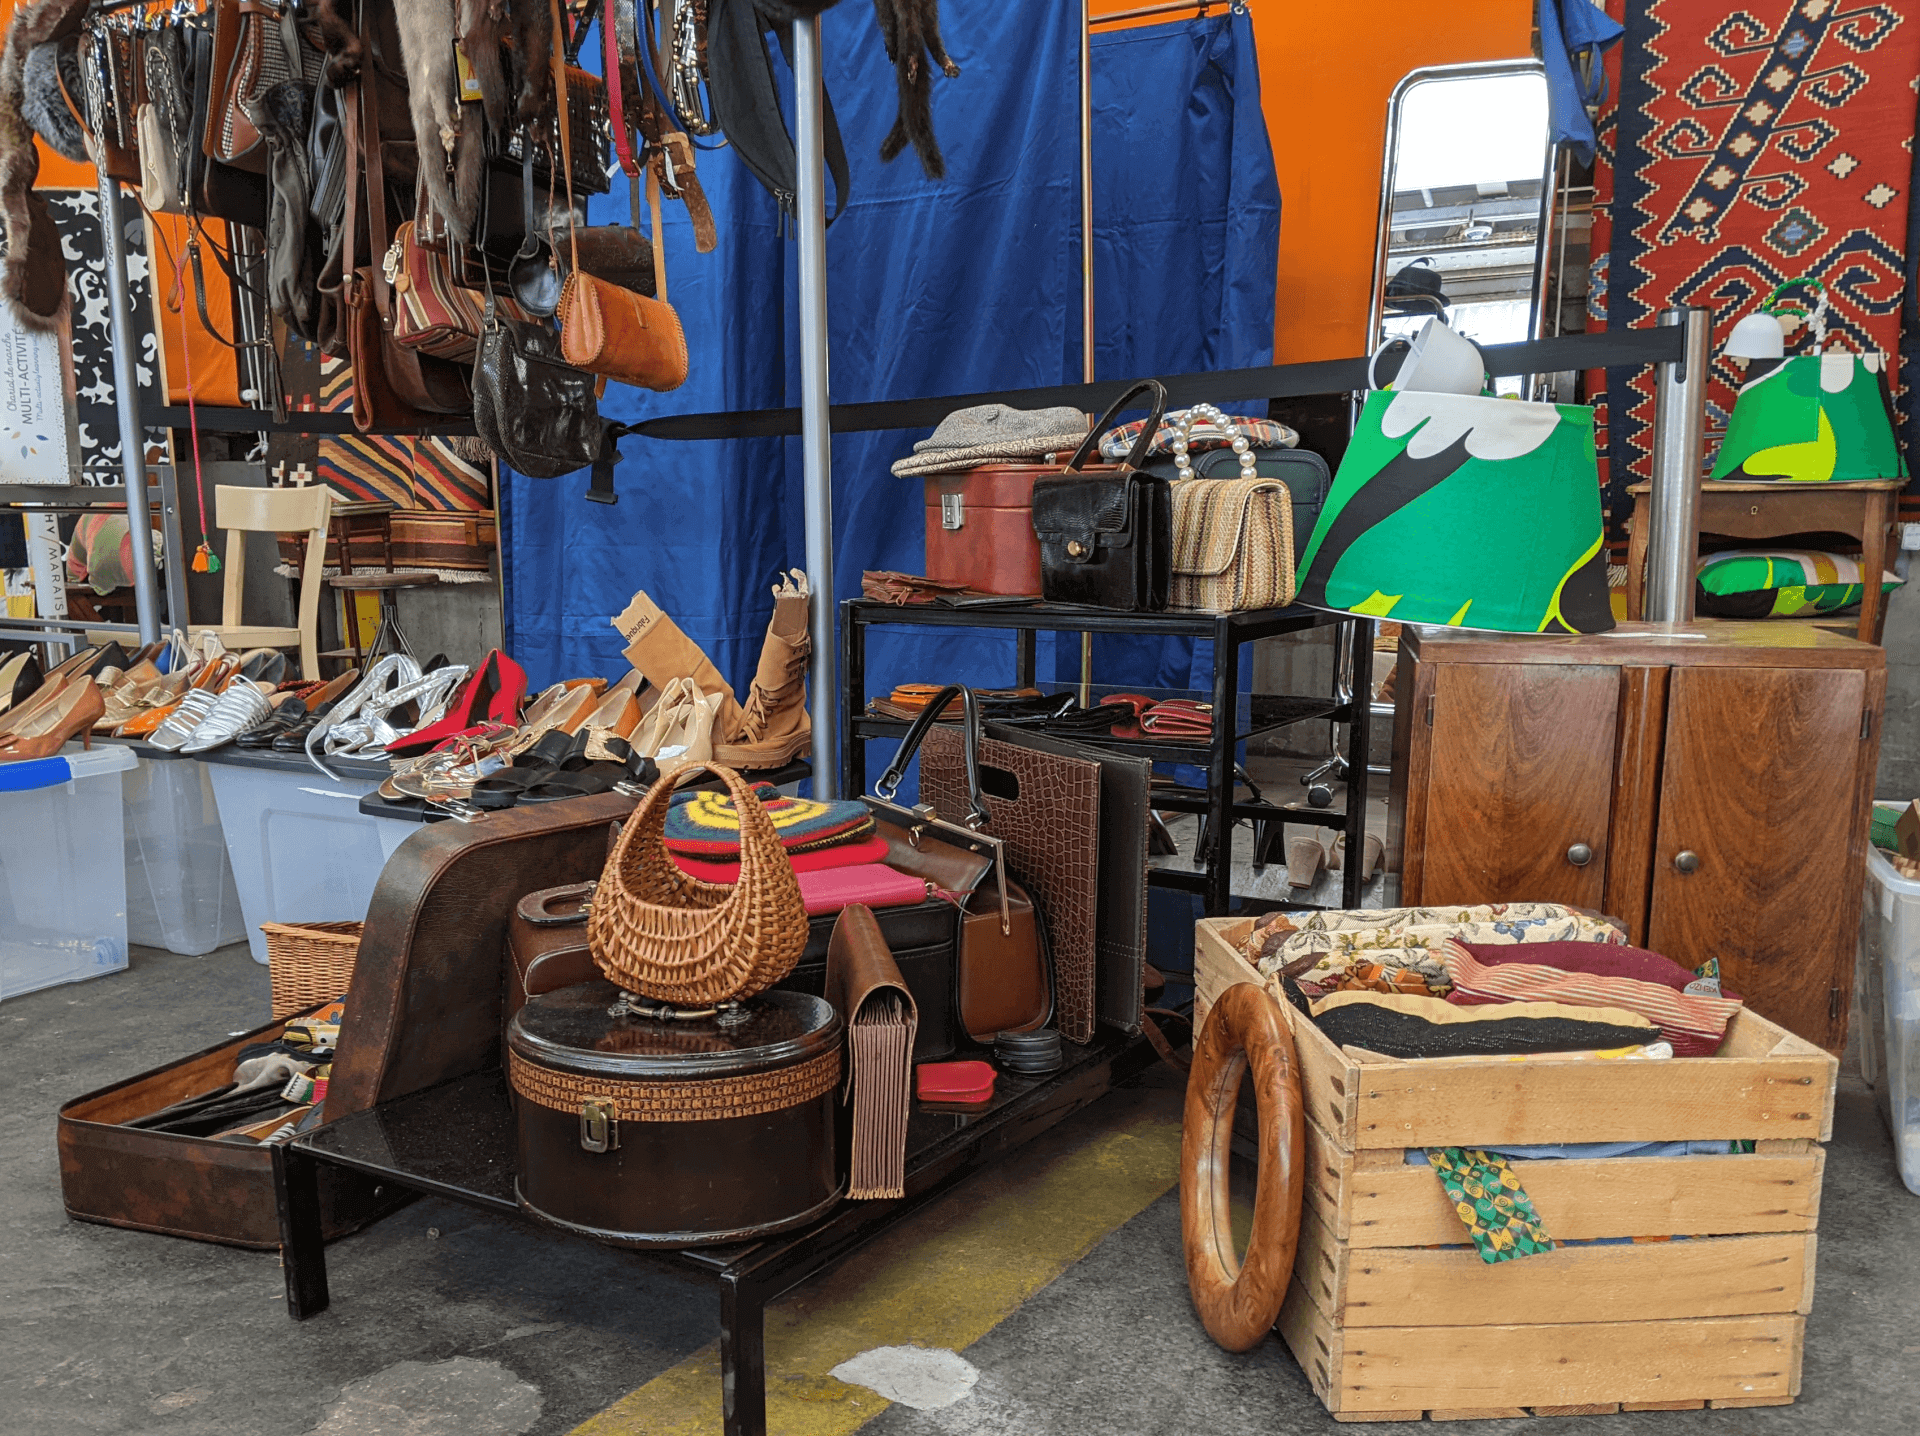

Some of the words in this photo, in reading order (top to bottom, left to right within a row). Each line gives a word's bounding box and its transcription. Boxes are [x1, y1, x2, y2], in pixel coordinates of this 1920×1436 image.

[2, 332, 13, 365] marche
[4, 365, 14, 377] de
[11, 328, 33, 425] MULTI-ACTIVITÉ
[7, 378, 17, 412] Chariot
[48, 547, 64, 611] MARAIS
